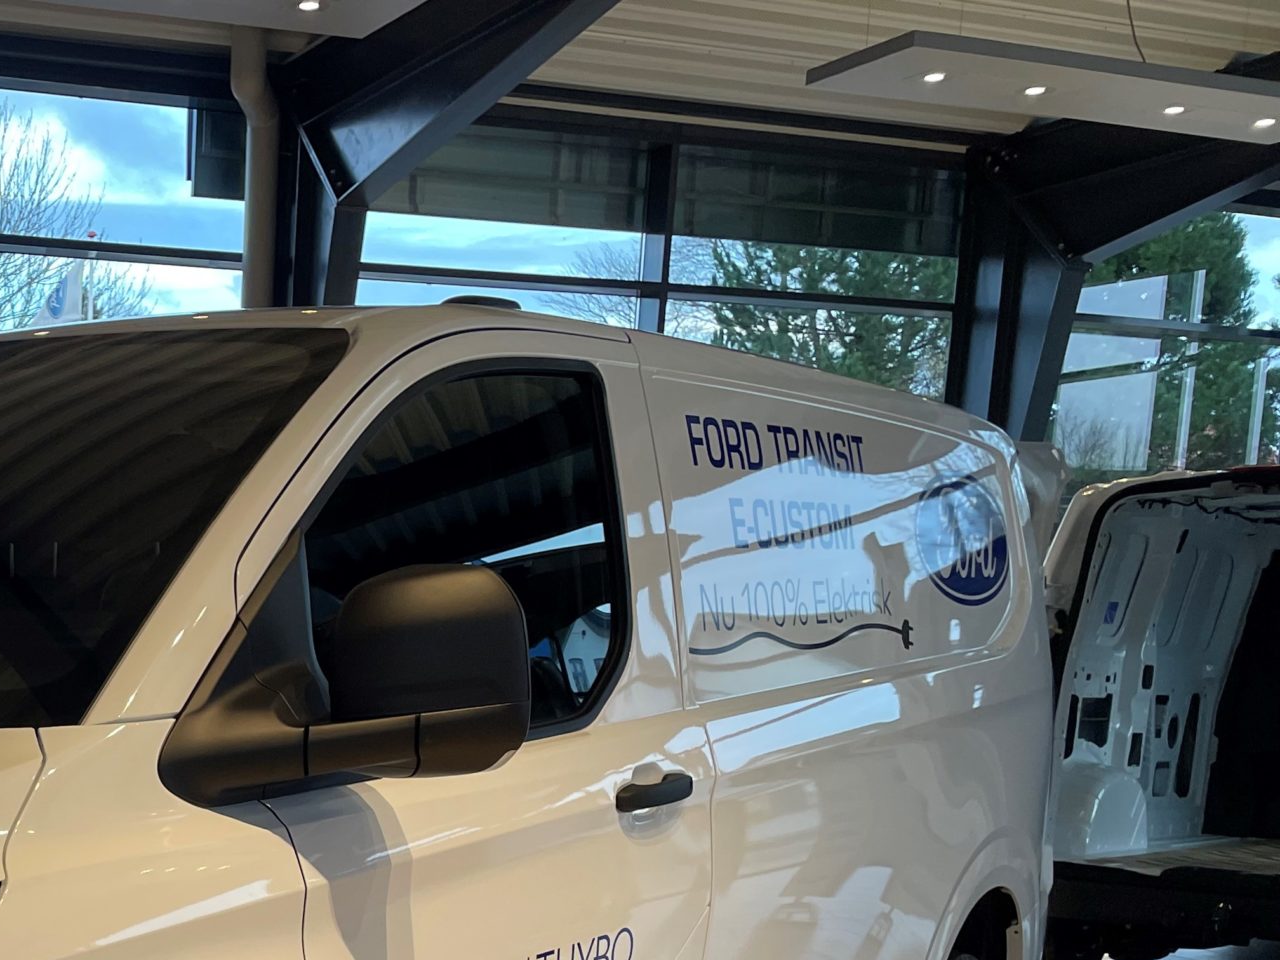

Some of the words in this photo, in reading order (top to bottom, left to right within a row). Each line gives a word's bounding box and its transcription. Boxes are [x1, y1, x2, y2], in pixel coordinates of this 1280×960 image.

[685, 415, 762, 470] FORD
[767, 426, 863, 478] TRANSIT
[728, 498, 856, 550] E-CUSTOM
[700, 584, 735, 631] Nu
[741, 578, 808, 627] 100%
[812, 577, 892, 624] Elektrisk
